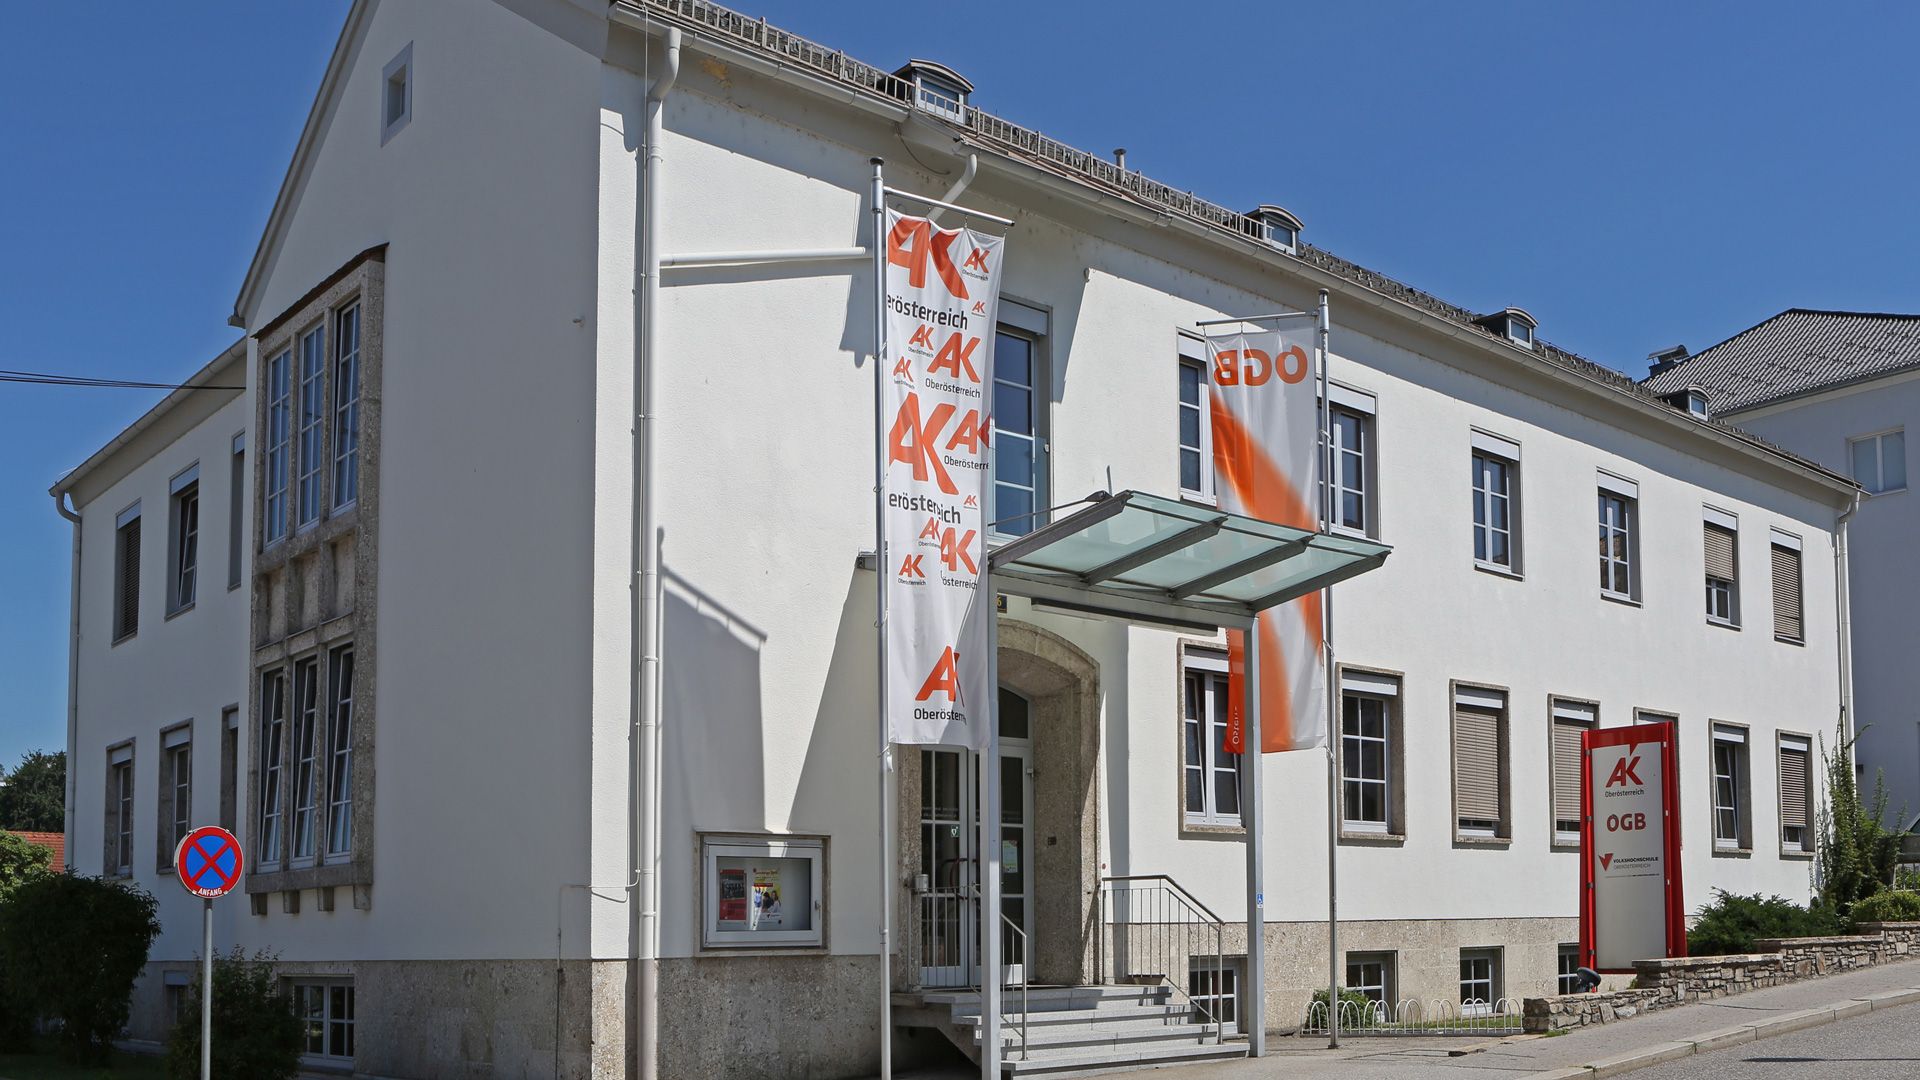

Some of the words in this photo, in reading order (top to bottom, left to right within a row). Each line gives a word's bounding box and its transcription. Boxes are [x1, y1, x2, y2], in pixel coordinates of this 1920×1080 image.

[963, 247, 990, 274] AK
[972, 300, 986, 314] AK
[909, 324, 934, 351] AK
[893, 355, 914, 383] AK
[927, 332, 981, 384] AK
[925, 378, 981, 399] Oberösterreich
[889, 392, 959, 495] AK
[963, 495, 978, 506] AK
[899, 554, 925, 578] AK
[1605, 756, 1644, 788] AK
[198, 887, 223, 897] ANFANG
